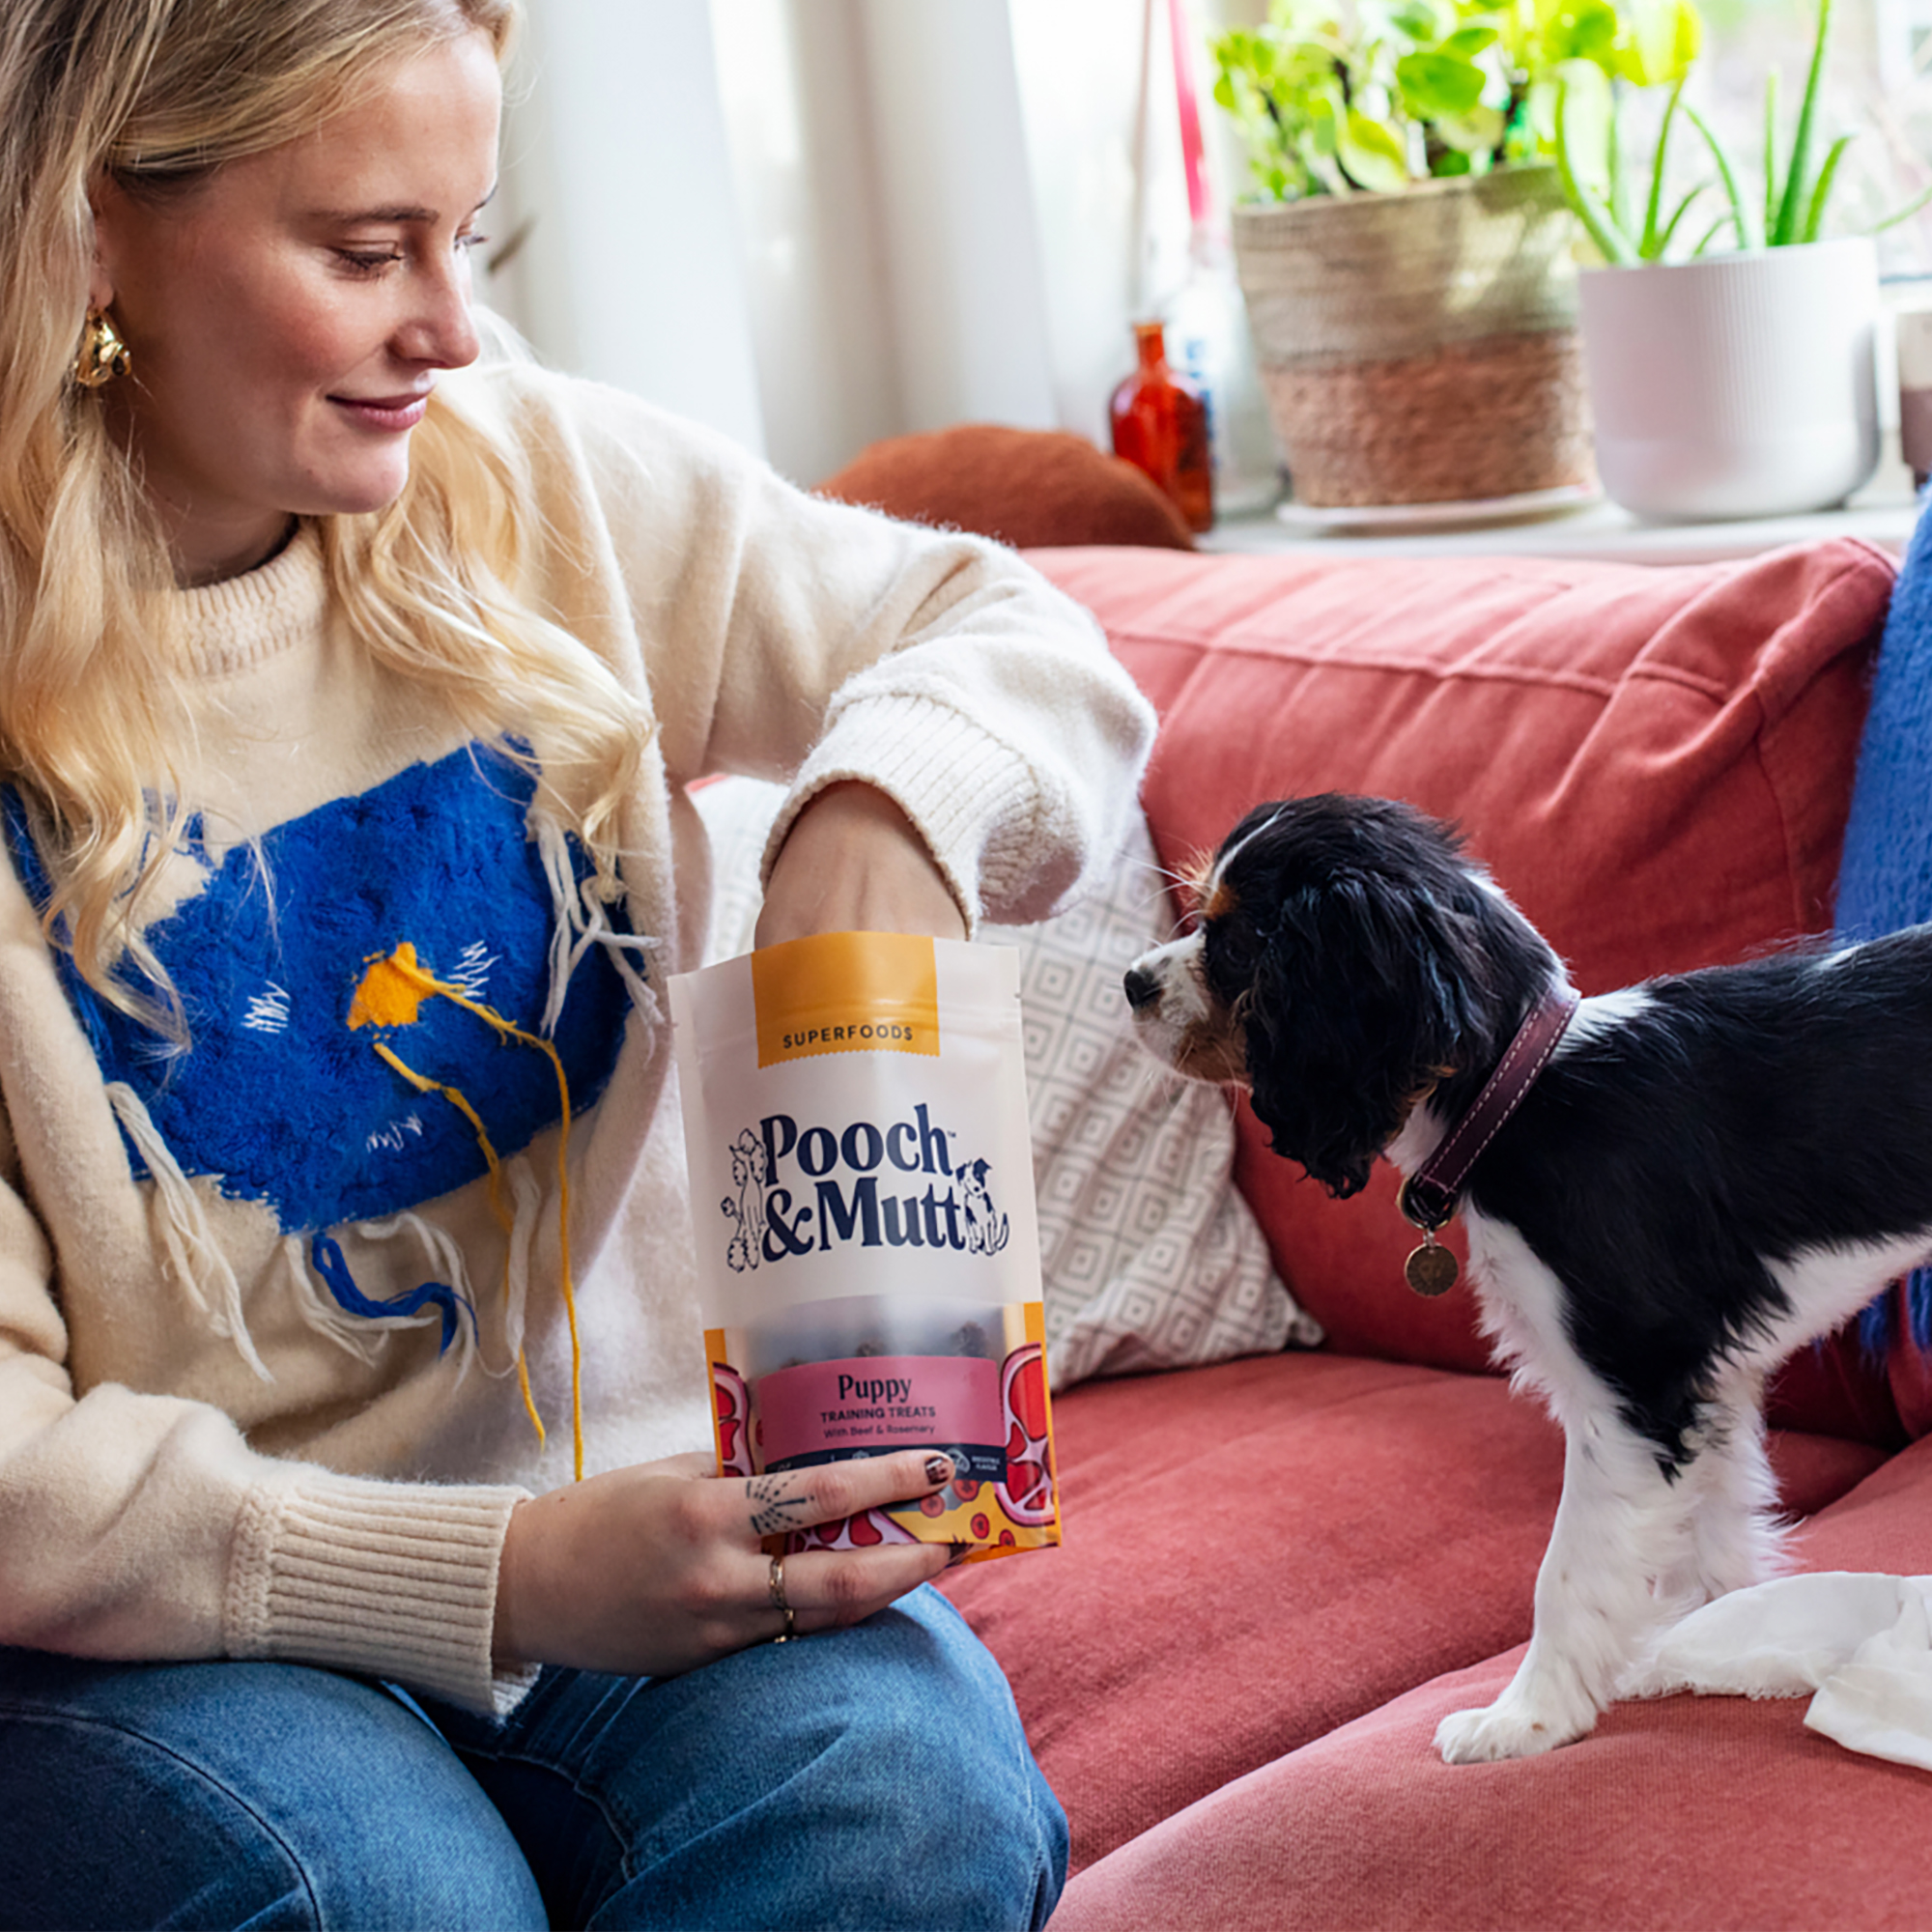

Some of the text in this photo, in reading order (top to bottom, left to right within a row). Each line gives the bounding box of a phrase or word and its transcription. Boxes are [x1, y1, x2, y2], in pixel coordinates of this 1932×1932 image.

[782, 1024, 913, 1049] SUPERFOODS
[759, 1103, 952, 1187] Pooch
[838, 1374, 912, 1405] Puppy
[820, 1406, 936, 1423] TRAINING TREATS
[824, 1424, 935, 1438] With Beef & Rosemary
